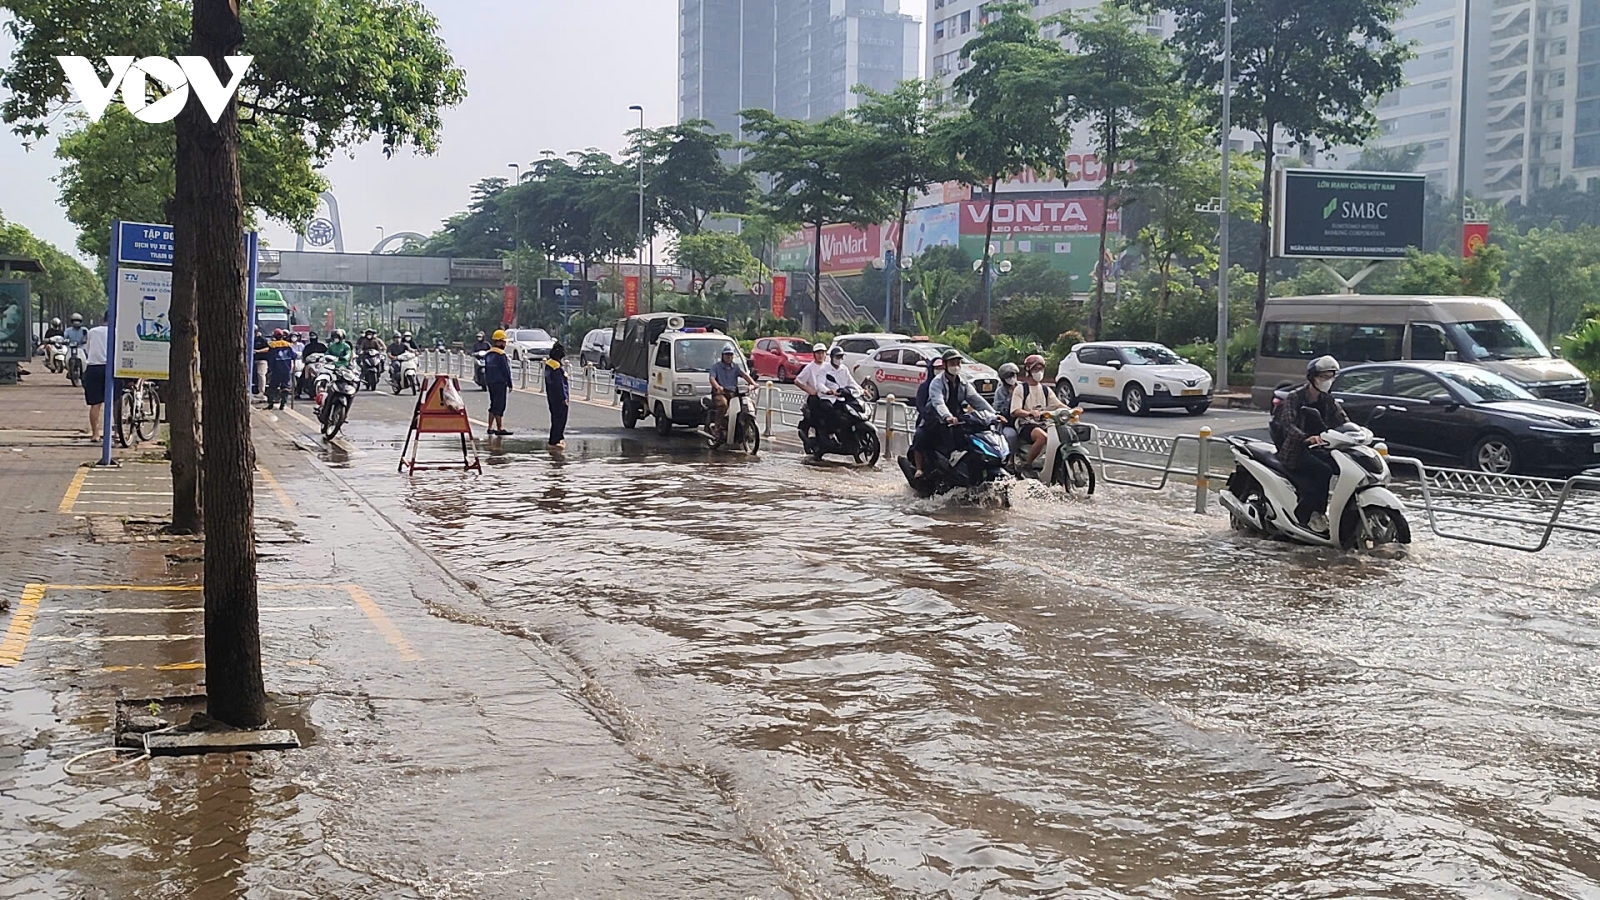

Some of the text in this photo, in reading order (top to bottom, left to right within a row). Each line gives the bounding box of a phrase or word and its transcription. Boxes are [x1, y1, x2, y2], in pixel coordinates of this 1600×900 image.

[1317, 180, 1330, 189] LỚN
[1331, 181, 1349, 190] MẠNH
[1350, 181, 1367, 190] CÙNG
[1368, 182, 1381, 191] VIỆT
[967, 202, 1087, 223] VONTA
[1342, 201, 1388, 219] SMBC
[143, 229, 161, 240] TẬP
[1022, 223, 1050, 232] THIẾT
[1064, 223, 1088, 232] ĐIỆN
[820, 232, 867, 262] WinMart
